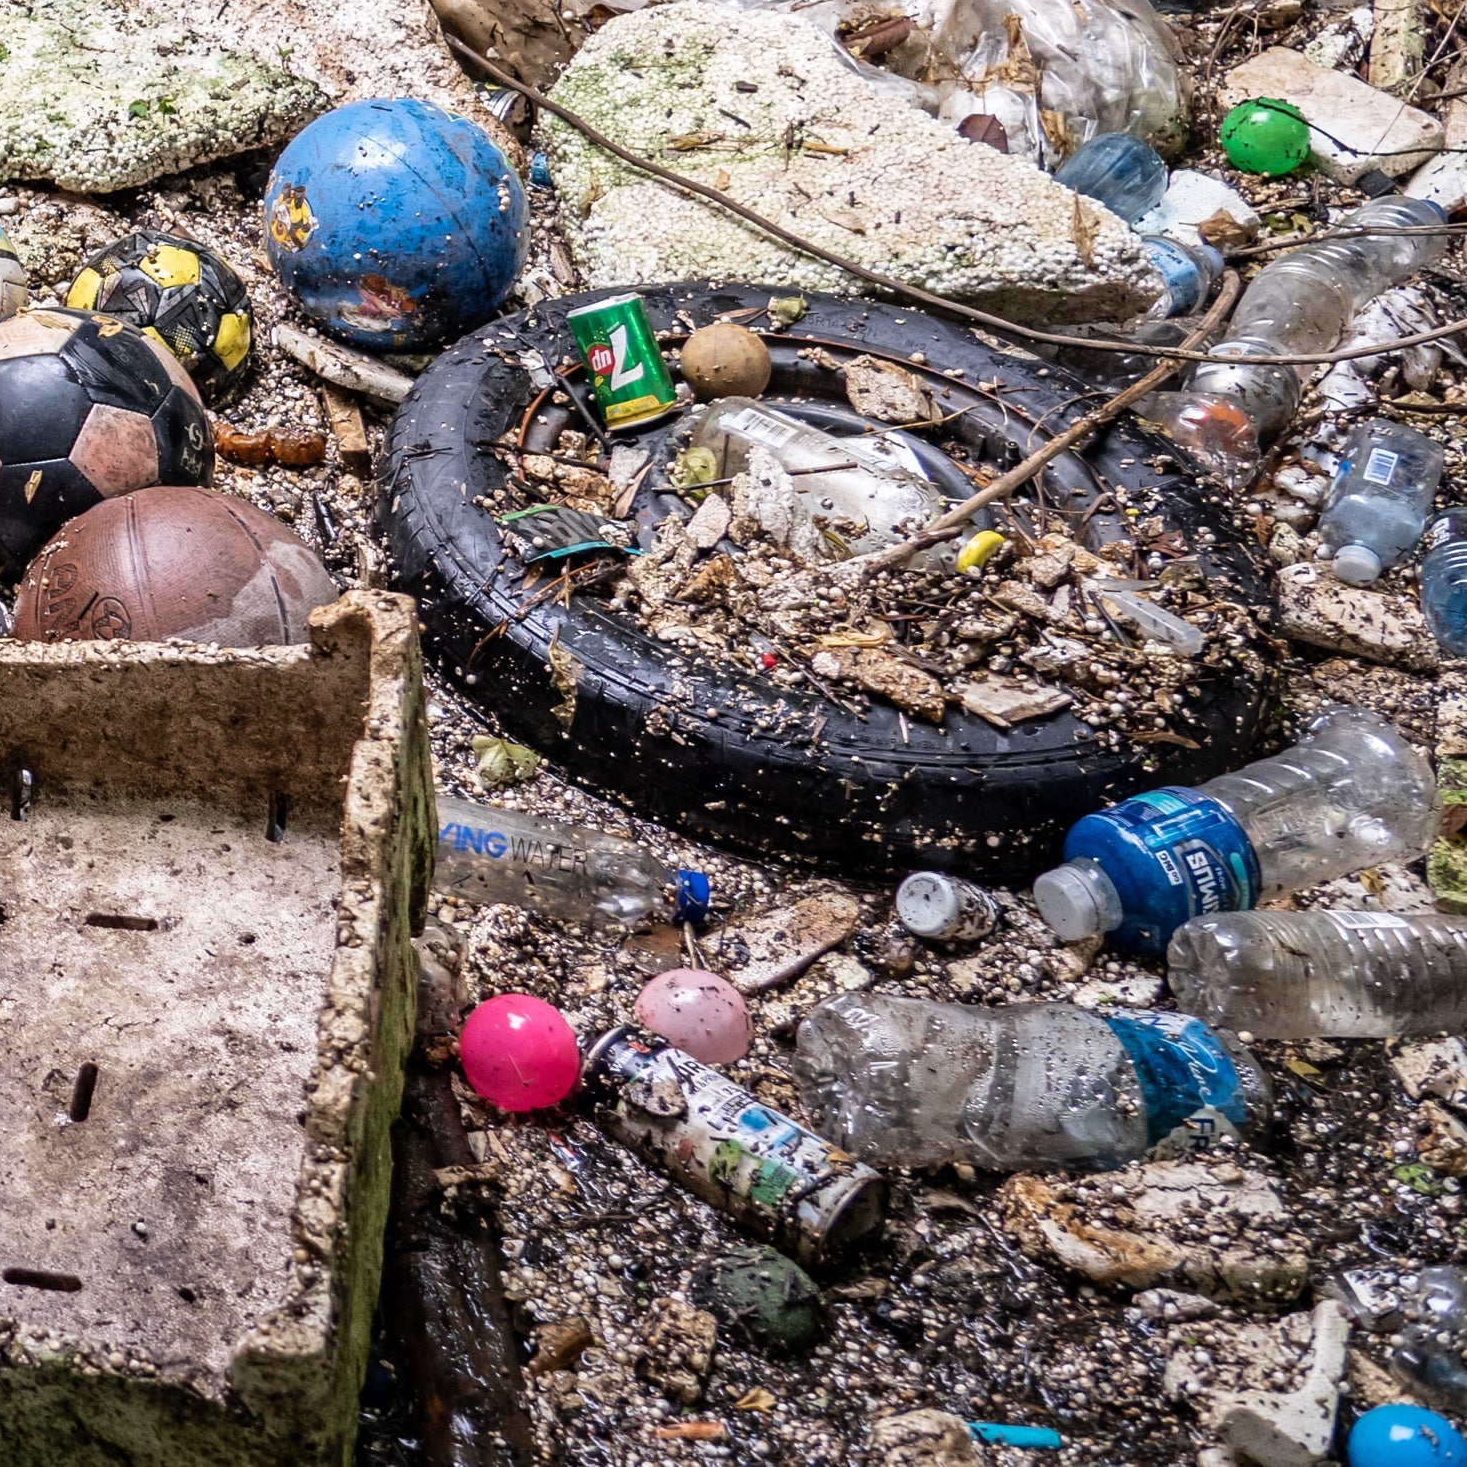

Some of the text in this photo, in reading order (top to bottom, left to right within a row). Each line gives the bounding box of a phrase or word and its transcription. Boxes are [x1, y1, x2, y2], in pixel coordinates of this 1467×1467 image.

[591, 324, 644, 392] 7 up
[511, 836, 587, 875] WATER
[1159, 851, 1181, 878] BIG
